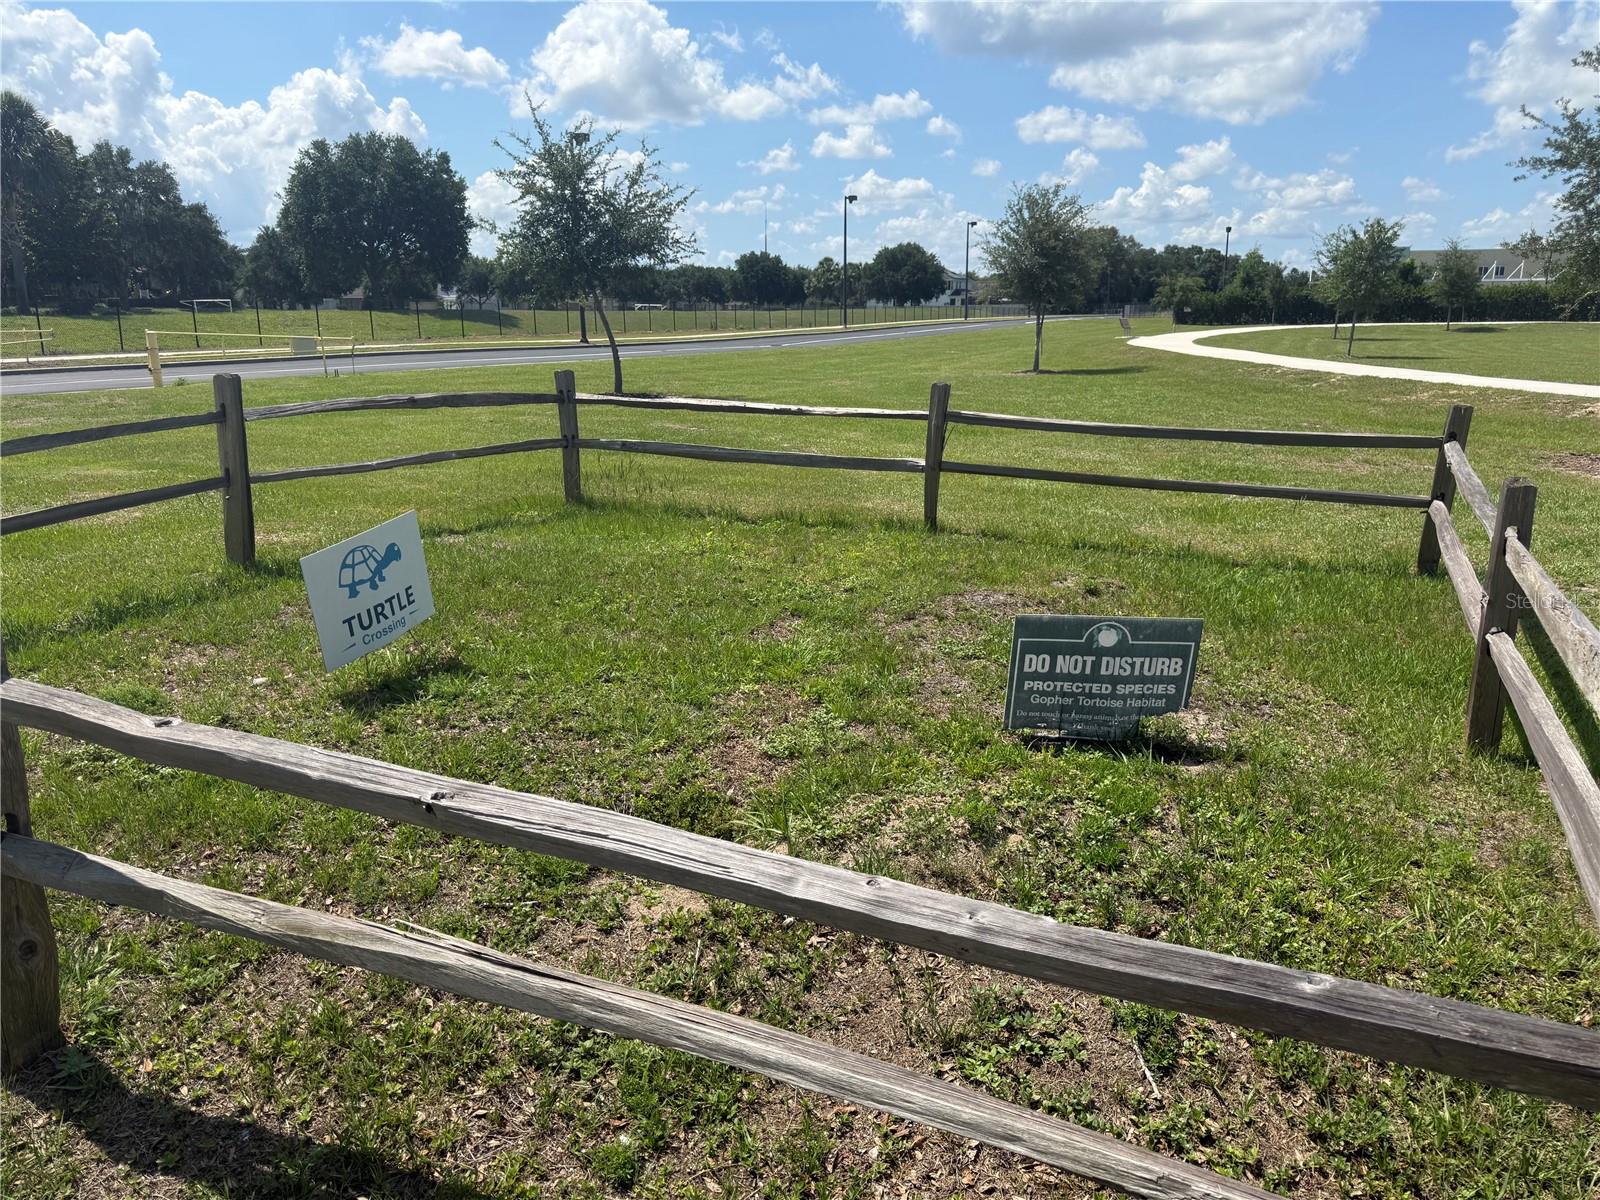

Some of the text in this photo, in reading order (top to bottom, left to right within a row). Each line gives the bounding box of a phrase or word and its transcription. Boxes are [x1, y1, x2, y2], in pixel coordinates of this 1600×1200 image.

[342, 585, 415, 637] TURTLE
[362, 616, 406, 645] Crossing
[1023, 654, 1183, 676] DO NOT DISTURB
[1023, 681, 1176, 695] PROTECTED SPECIES
[1030, 694, 1166, 708] Gopher Tortoise Habitat
